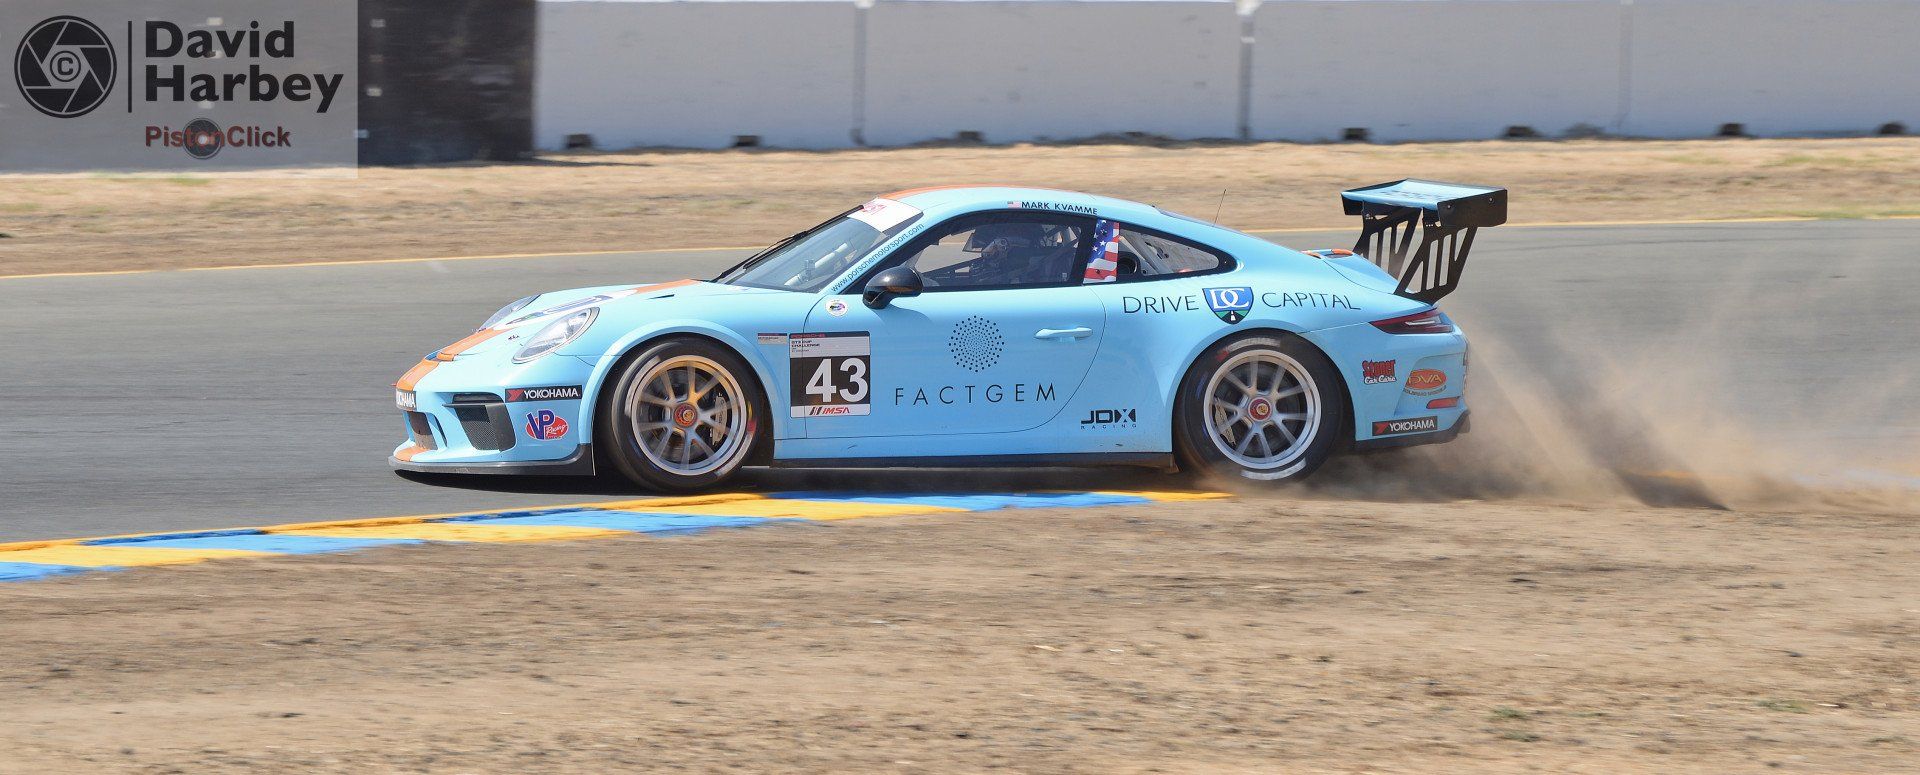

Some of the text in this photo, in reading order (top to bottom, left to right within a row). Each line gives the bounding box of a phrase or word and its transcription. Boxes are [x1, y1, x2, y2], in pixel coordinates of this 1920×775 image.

[1021, 201, 1098, 215] MARK KVAMME
[830, 223, 925, 292] www.porschemotorsport.com
[1122, 292, 1362, 314] DRIVE CAPITAL
[1209, 288, 1250, 309] DC
[805, 357, 869, 403] 43
[523, 387, 579, 399] YOKOHAMA
[895, 383, 1056, 406] FACTGEM
[822, 406, 851, 415] IMSA
[1080, 409, 1137, 424] JDX
[526, 409, 555, 440] VP
[1389, 419, 1435, 432] YOKOHAMA
